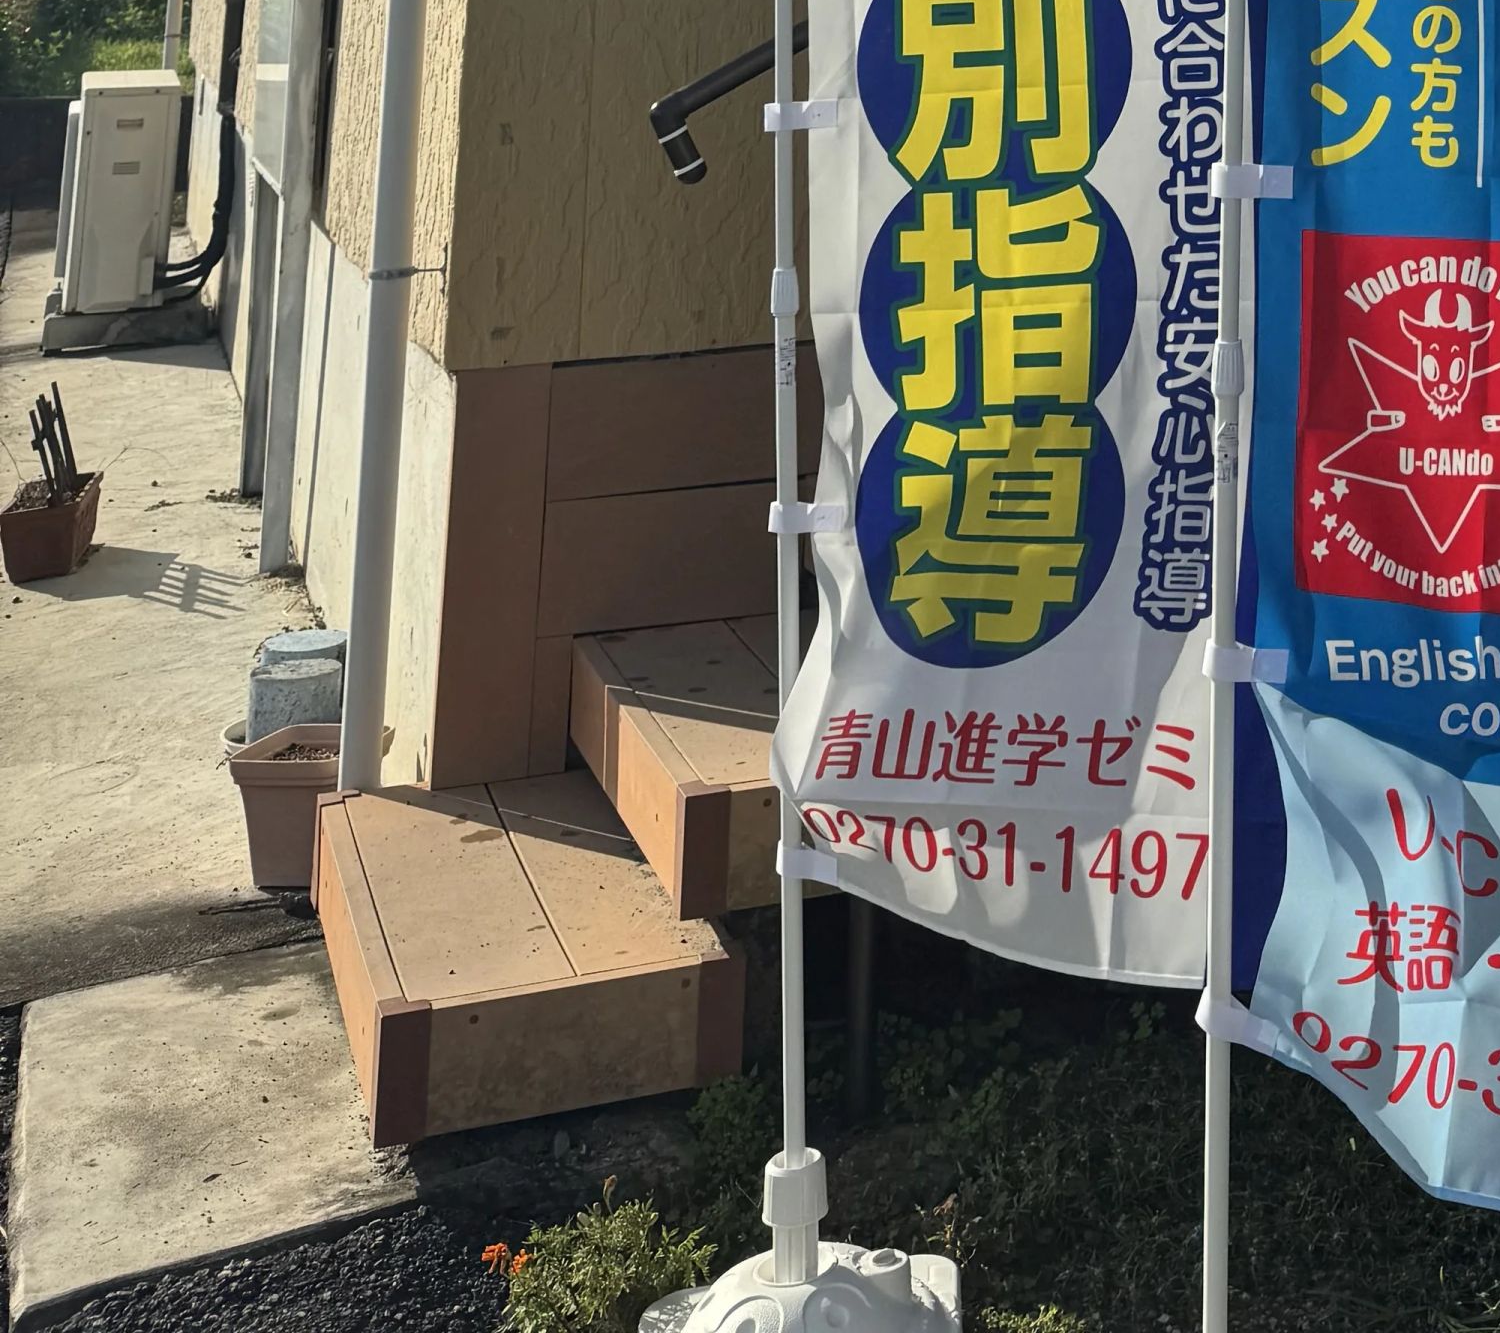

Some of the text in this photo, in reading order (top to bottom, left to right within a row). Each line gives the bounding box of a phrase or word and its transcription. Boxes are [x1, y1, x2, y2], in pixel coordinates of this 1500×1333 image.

[1344, 265, 1401, 313] You
[1401, 256, 1456, 287] can
[1461, 256, 1498, 293] do
[1399, 447, 1494, 476] U-CANdo
[1335, 521, 1373, 563] Put
[1370, 549, 1419, 590] your
[1421, 570, 1479, 597] back
[814, 708, 1196, 790] 青山進学ゼミ
[802, 807, 1209, 901] 0270-31-1497
